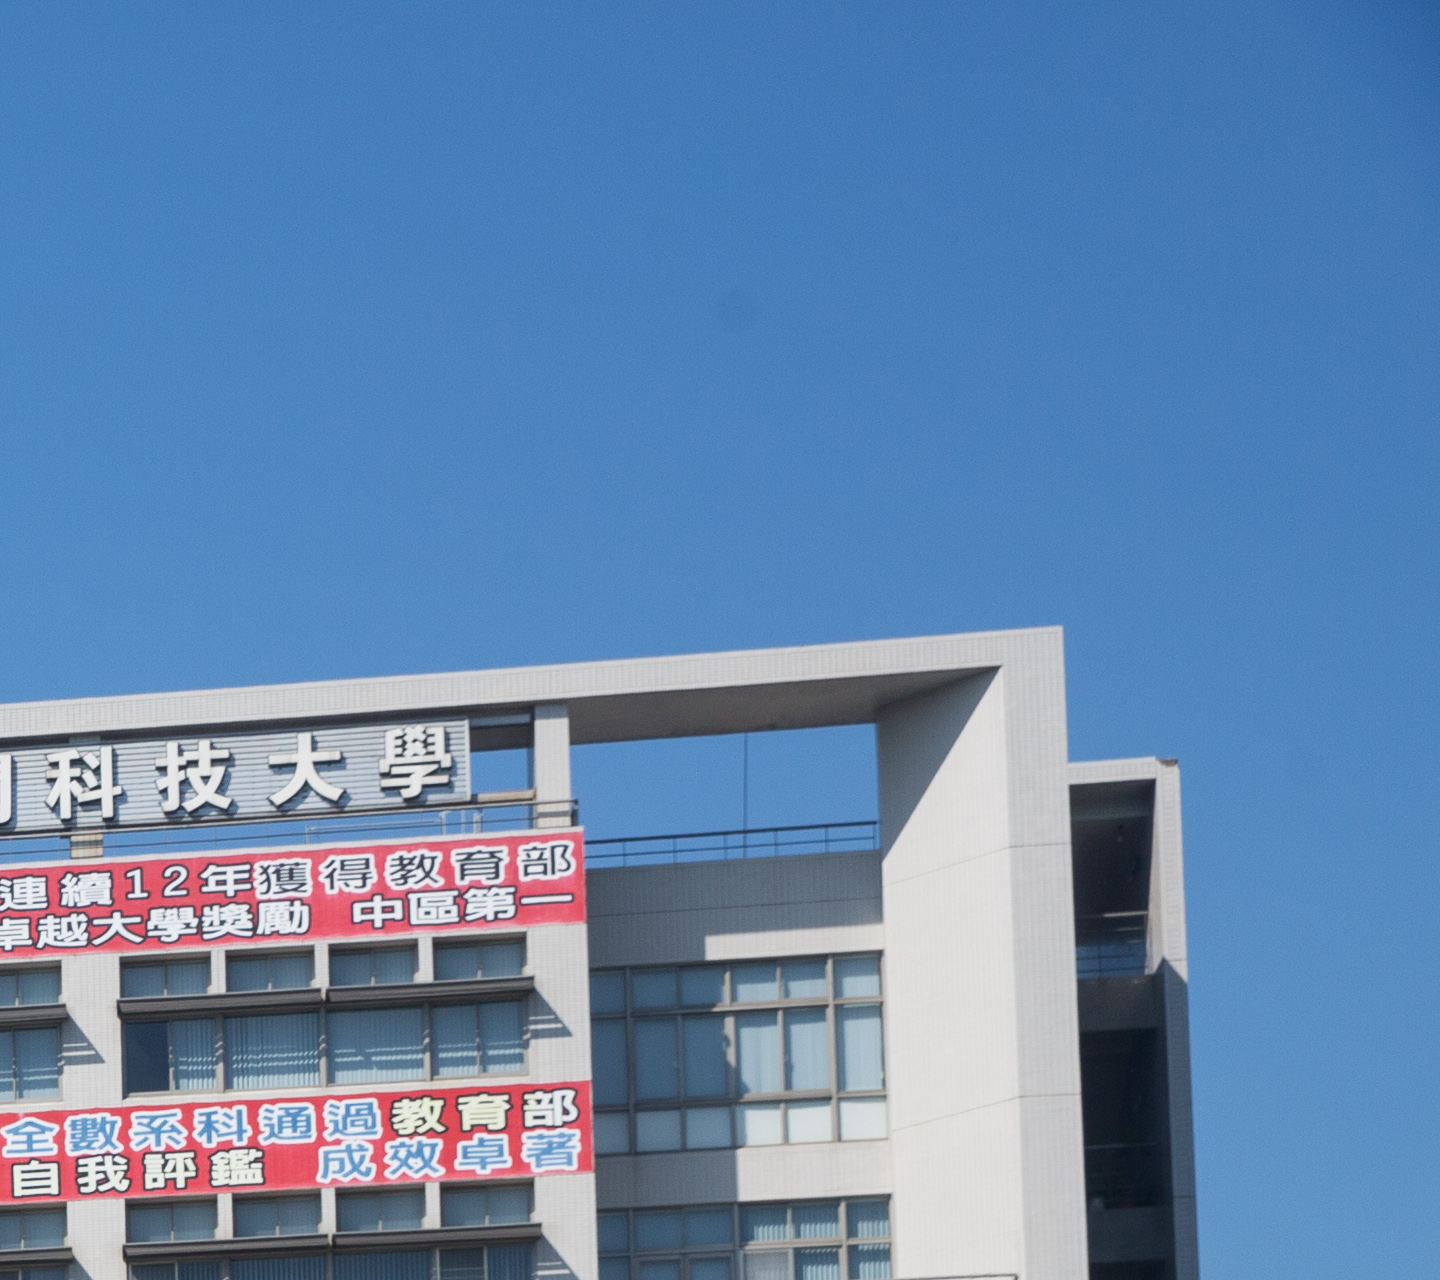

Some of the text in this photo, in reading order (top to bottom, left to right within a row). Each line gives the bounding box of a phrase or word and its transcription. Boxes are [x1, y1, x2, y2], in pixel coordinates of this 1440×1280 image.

[352, 887, 574, 928] 中區第一
[317, 1130, 581, 1182] 成效卓著
